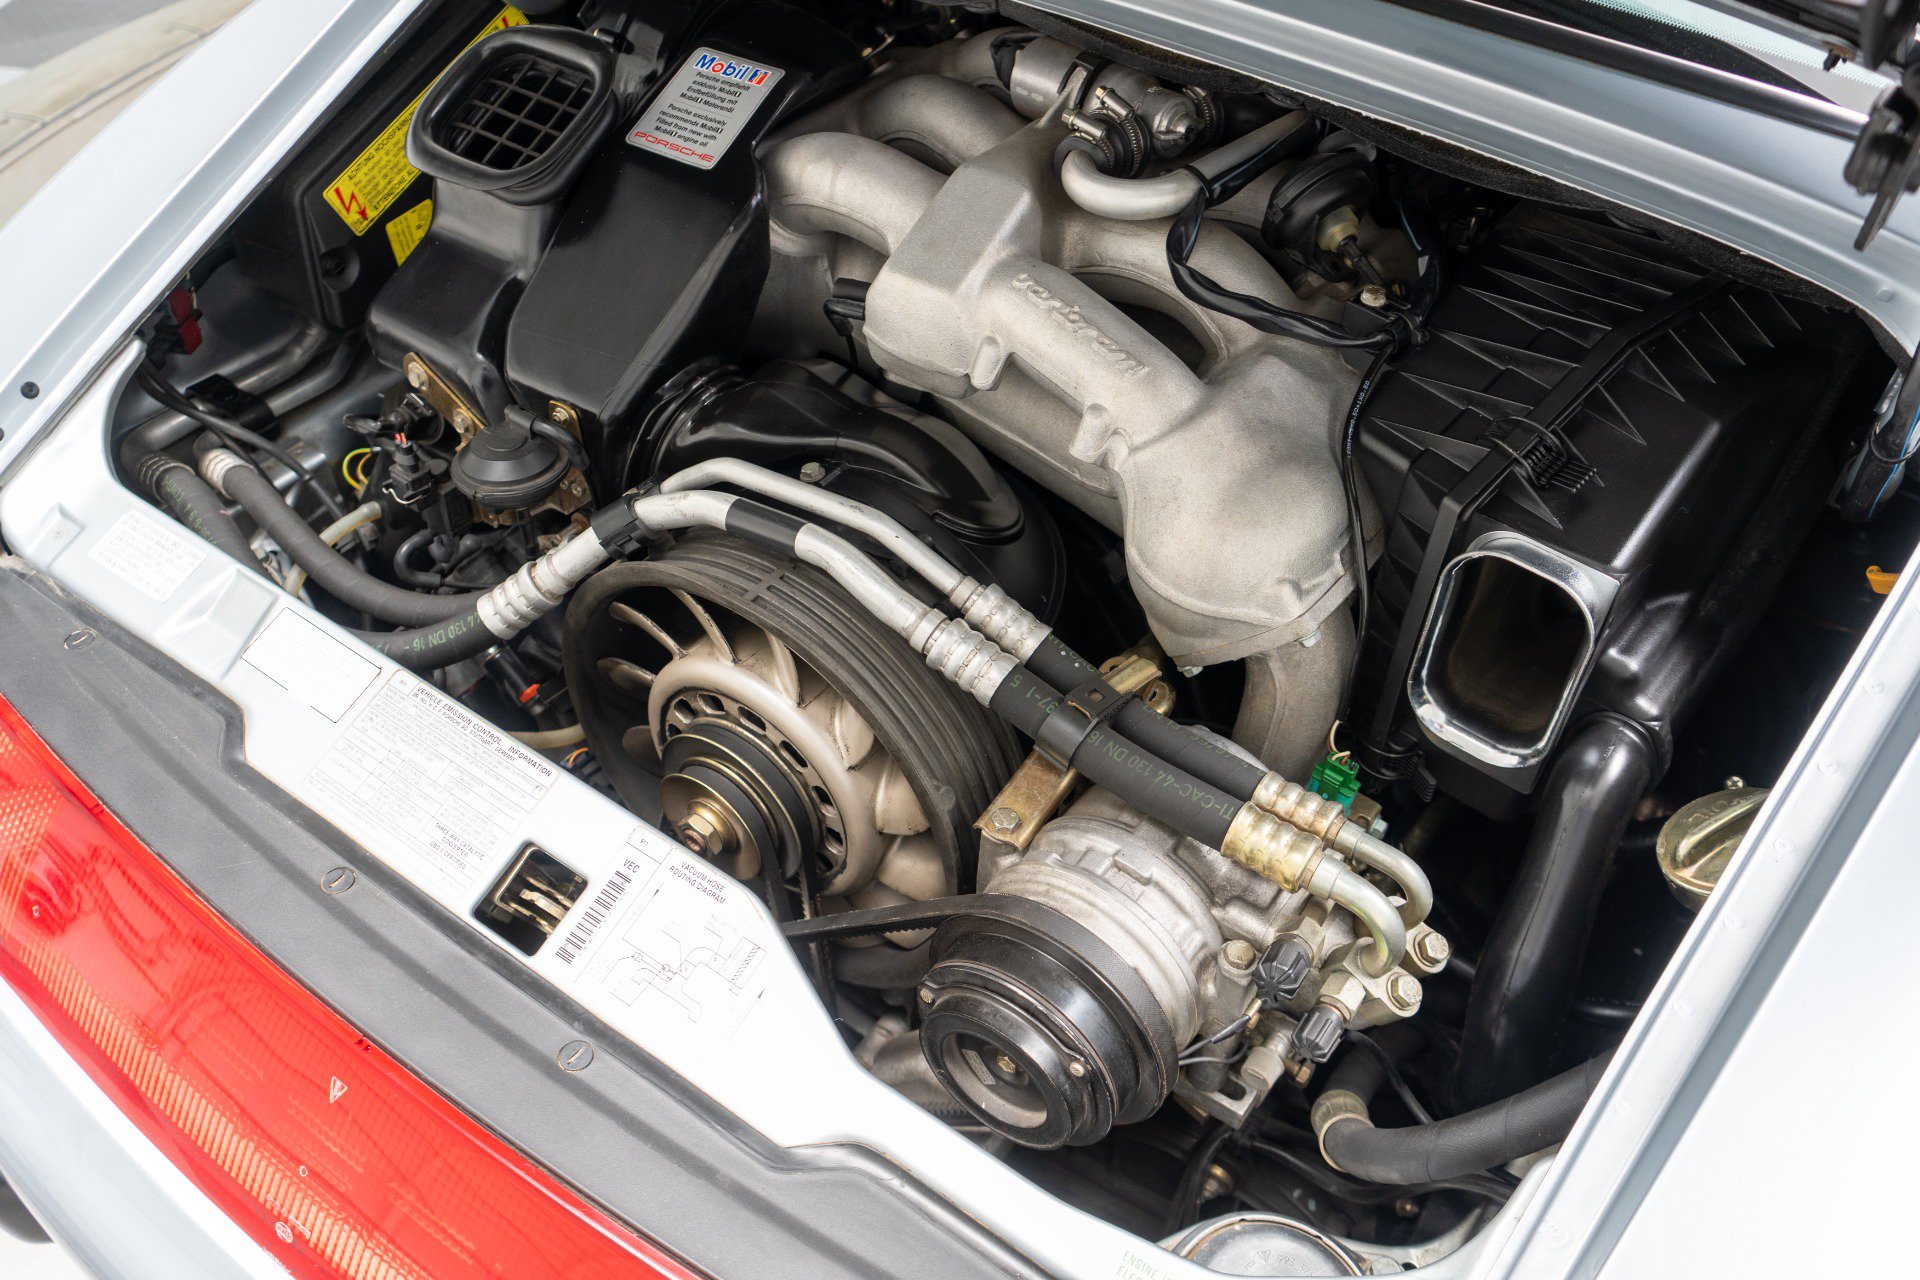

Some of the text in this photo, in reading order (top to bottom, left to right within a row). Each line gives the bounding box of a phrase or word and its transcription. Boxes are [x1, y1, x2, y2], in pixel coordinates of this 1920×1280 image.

[694, 53, 748, 81] Mobil
[693, 79, 717, 91] exklusiv
[696, 72, 750, 92] Porsche empfiehlt
[686, 86, 738, 106] Erstbefüllung mit
[668, 103, 727, 127] Porsche exclusively
[702, 100, 735, 114] Motorenöl
[655, 117, 717, 141] Filled from new with
[659, 110, 699, 127] recommends
[634, 131, 715, 163] PORSCHE
[677, 133, 699, 146] engine
[699, 139, 708, 148] oil
[347, 151, 376, 181] ACHTUNG
[427, 630, 448, 648] DN
[447, 620, 468, 639] 130
[412, 637, 426, 652] 16
[416, 686, 553, 778] VEHICLE EMISSION CONTROL INFORMATION
[1086, 729, 1105, 749] 16
[1102, 739, 1130, 763] DN
[1126, 752, 1153, 780] 130
[434, 822, 450, 836] THREE
[449, 831, 461, 844] WAY
[622, 858, 641, 875] VEC
[681, 861, 726, 893] VACUUM HOSE
[668, 865, 726, 905] ROUTING DIAGRAM
